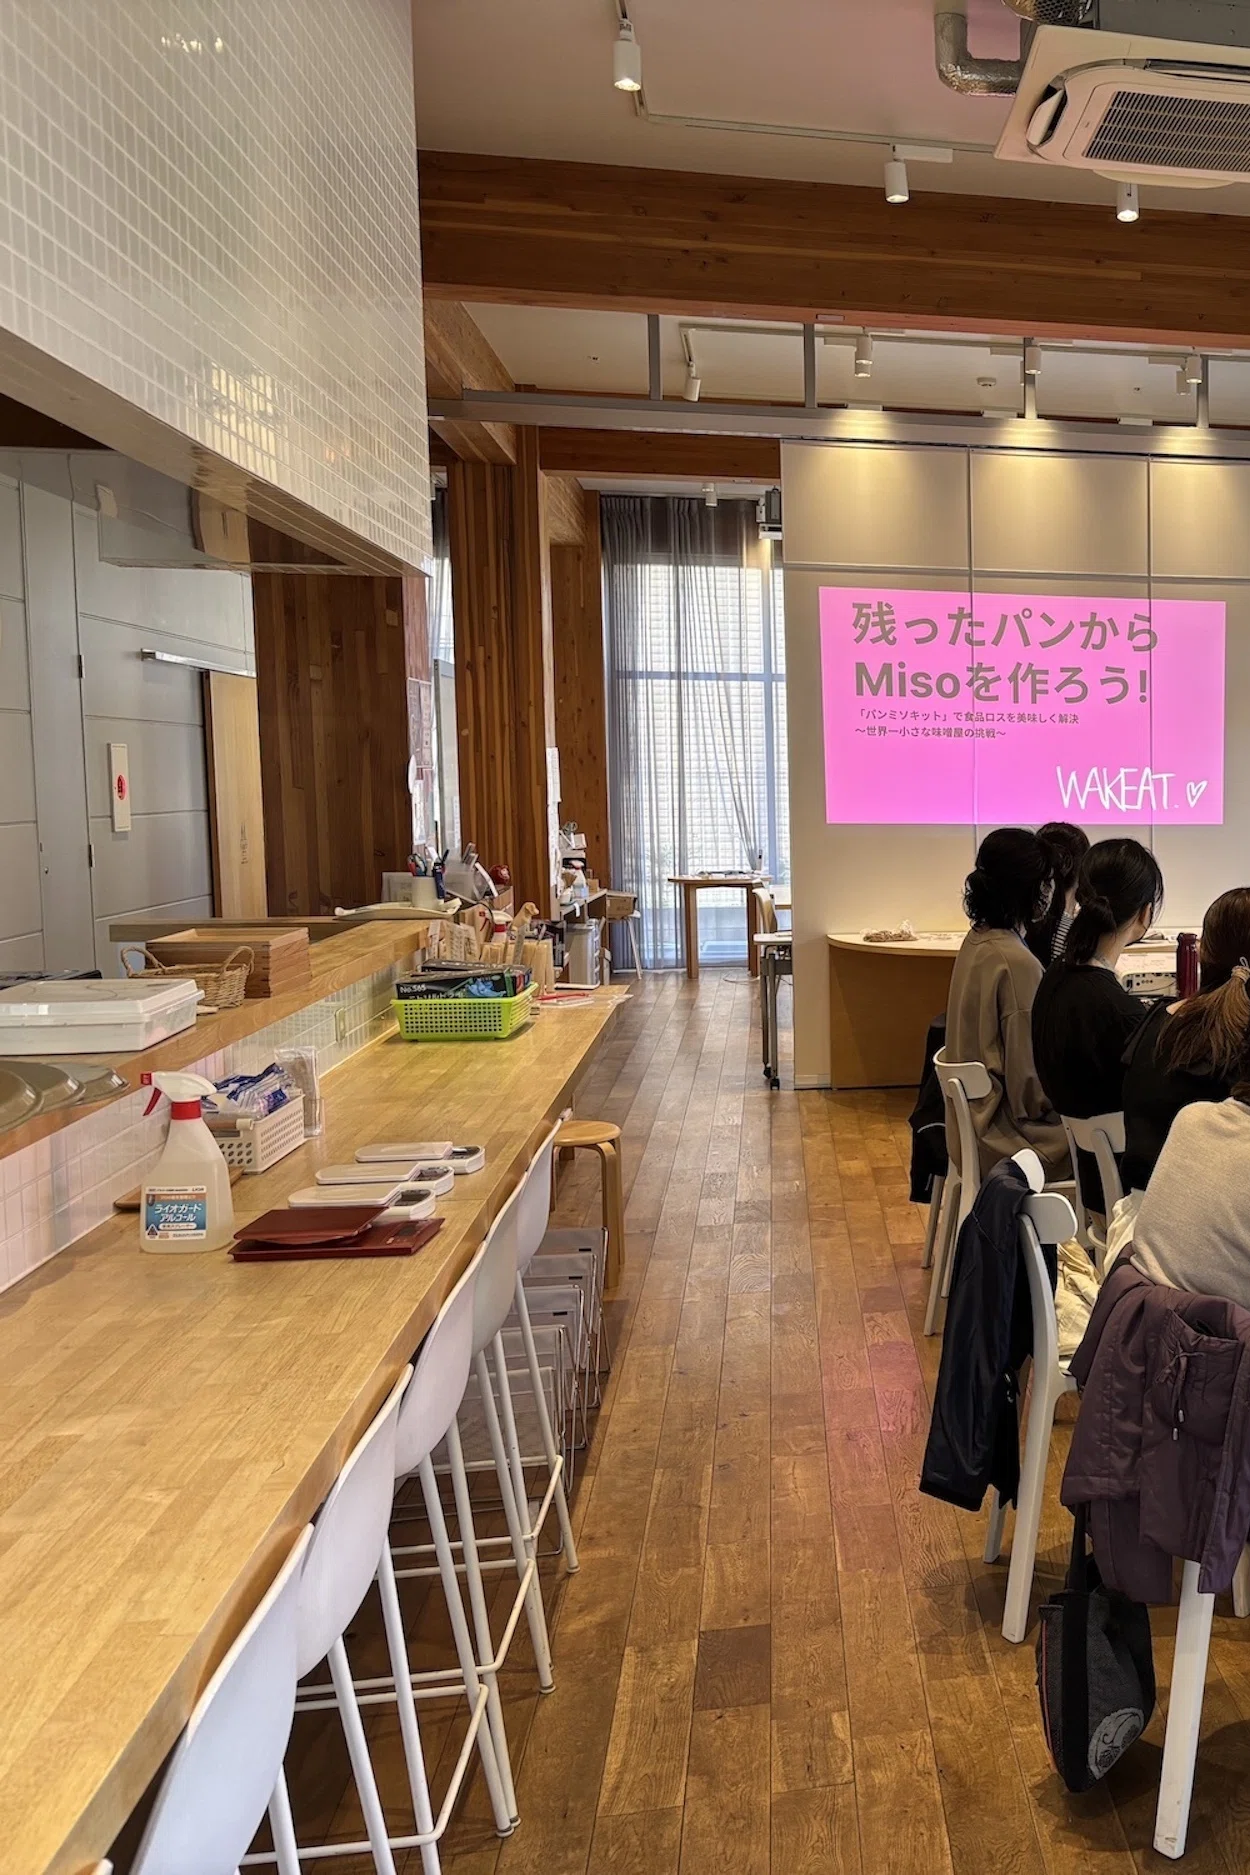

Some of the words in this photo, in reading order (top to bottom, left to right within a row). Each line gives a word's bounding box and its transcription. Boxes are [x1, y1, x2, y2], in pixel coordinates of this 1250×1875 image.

[852, 600, 1158, 652] 残ったパンから
[855, 661, 1148, 705] Misoを作ろう!
[859, 708, 1080, 724] 「パンミソキット」で食品ロスを美味しく解決
[154, 1203, 202, 1214] ライオガード
[160, 1213, 197, 1222] アルコール
